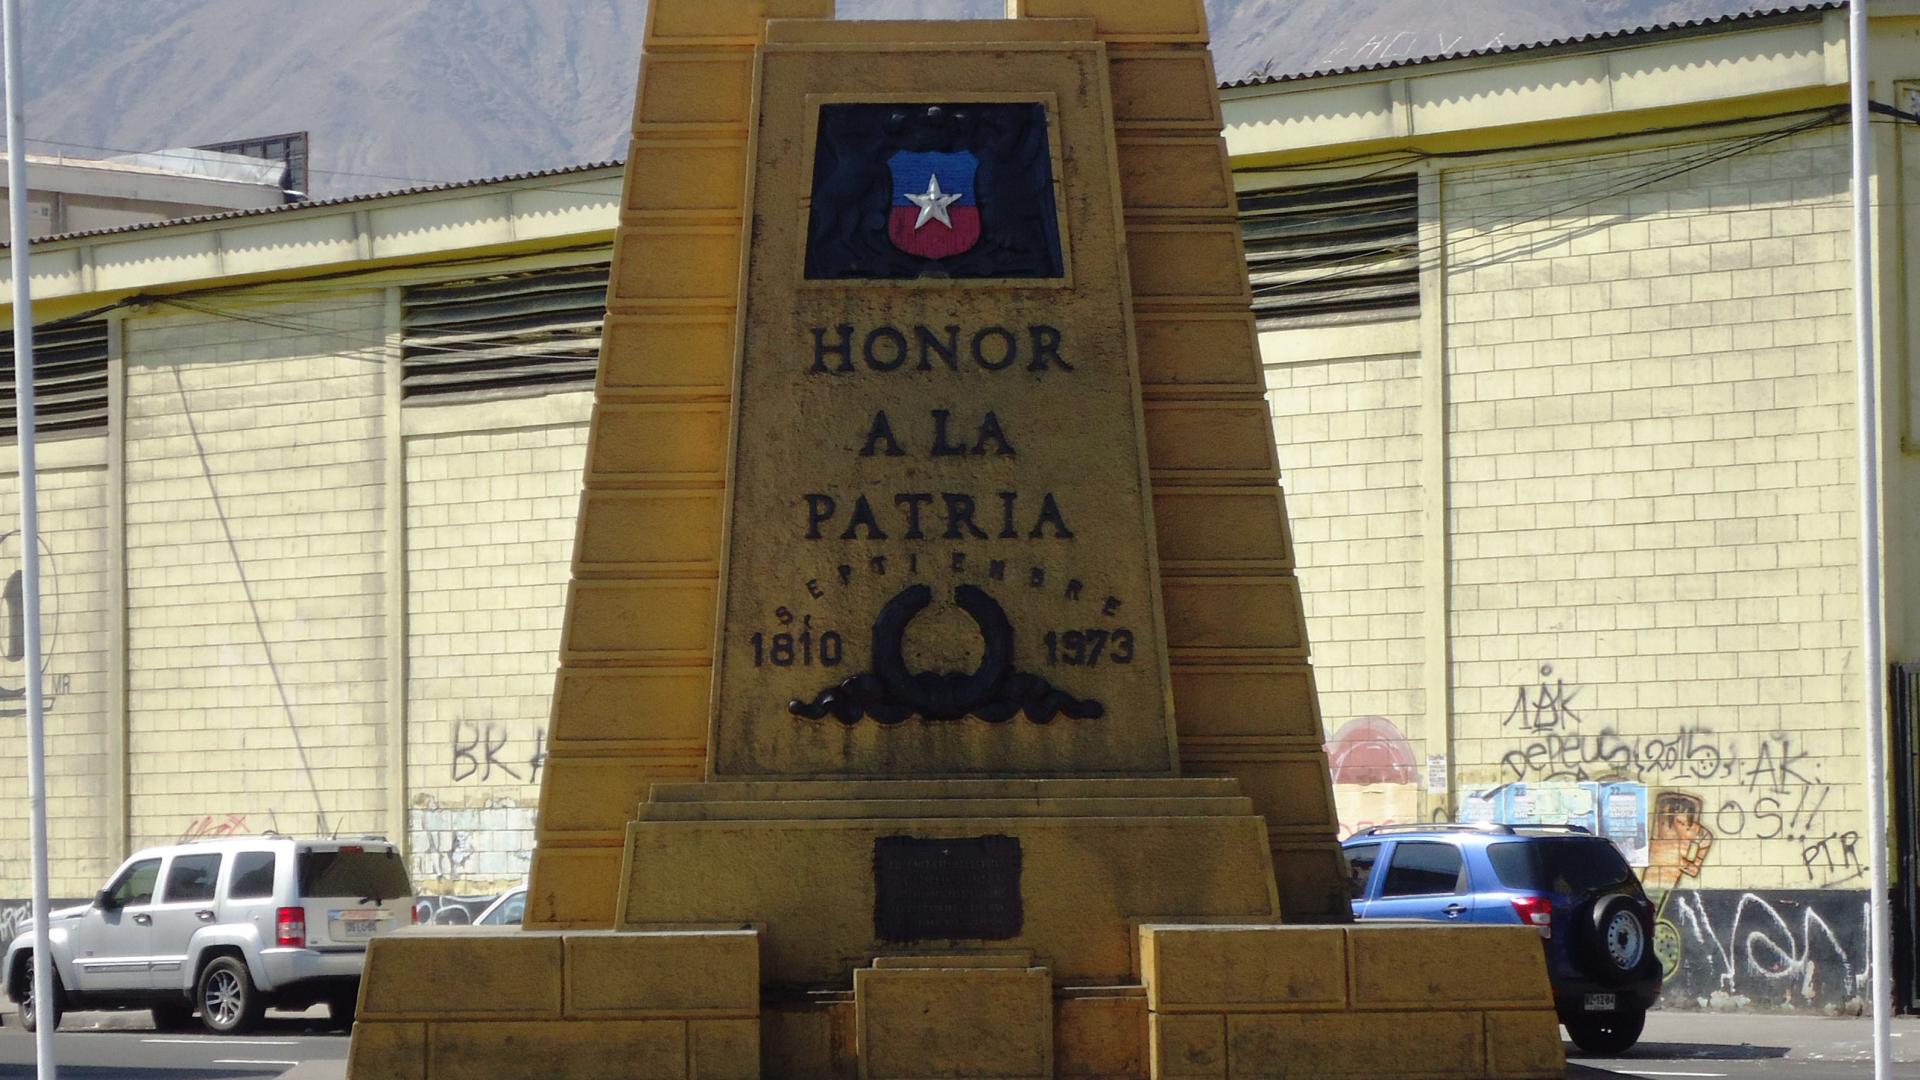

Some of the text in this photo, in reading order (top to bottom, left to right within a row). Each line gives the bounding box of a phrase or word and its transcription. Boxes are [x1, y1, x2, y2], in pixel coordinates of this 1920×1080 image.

[811, 324, 1074, 372] HONOR
[859, 409, 1016, 456] A LA
[803, 493, 1074, 539] PATRIA
[775, 552, 1122, 627] SEPTIEMBRE
[751, 630, 844, 667] 1810
[1043, 628, 1135, 666] 1973
